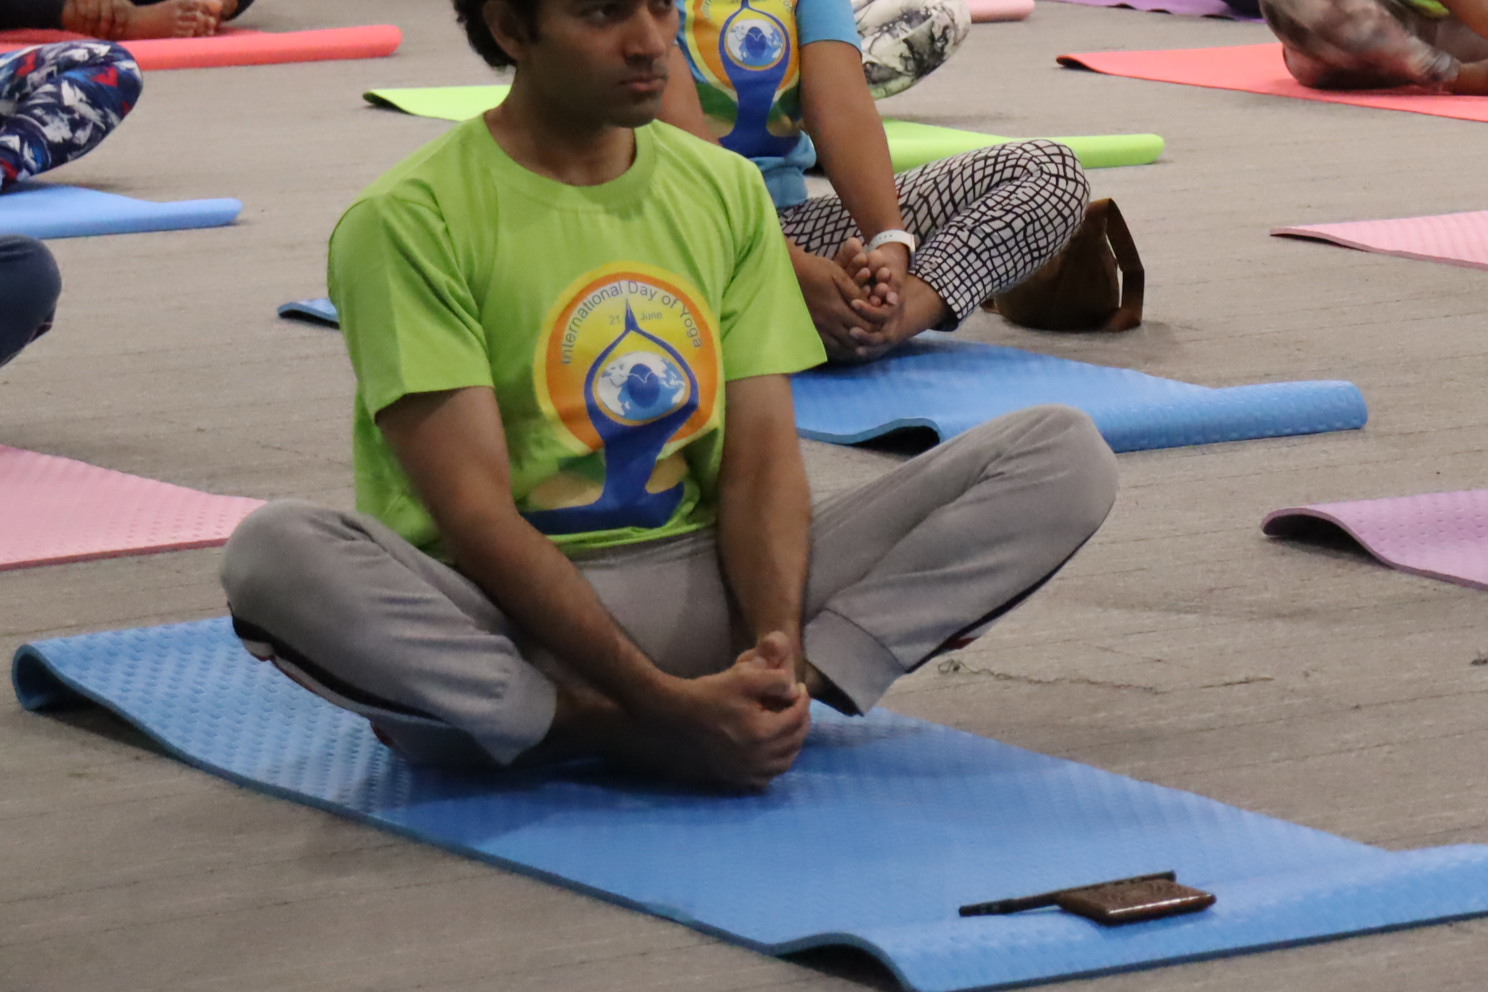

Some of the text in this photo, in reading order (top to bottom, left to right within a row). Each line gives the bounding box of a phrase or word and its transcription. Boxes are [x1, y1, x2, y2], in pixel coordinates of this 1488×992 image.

[561, 280, 704, 365] International Day of Yoga
[609, 311, 663, 326] 21 June
